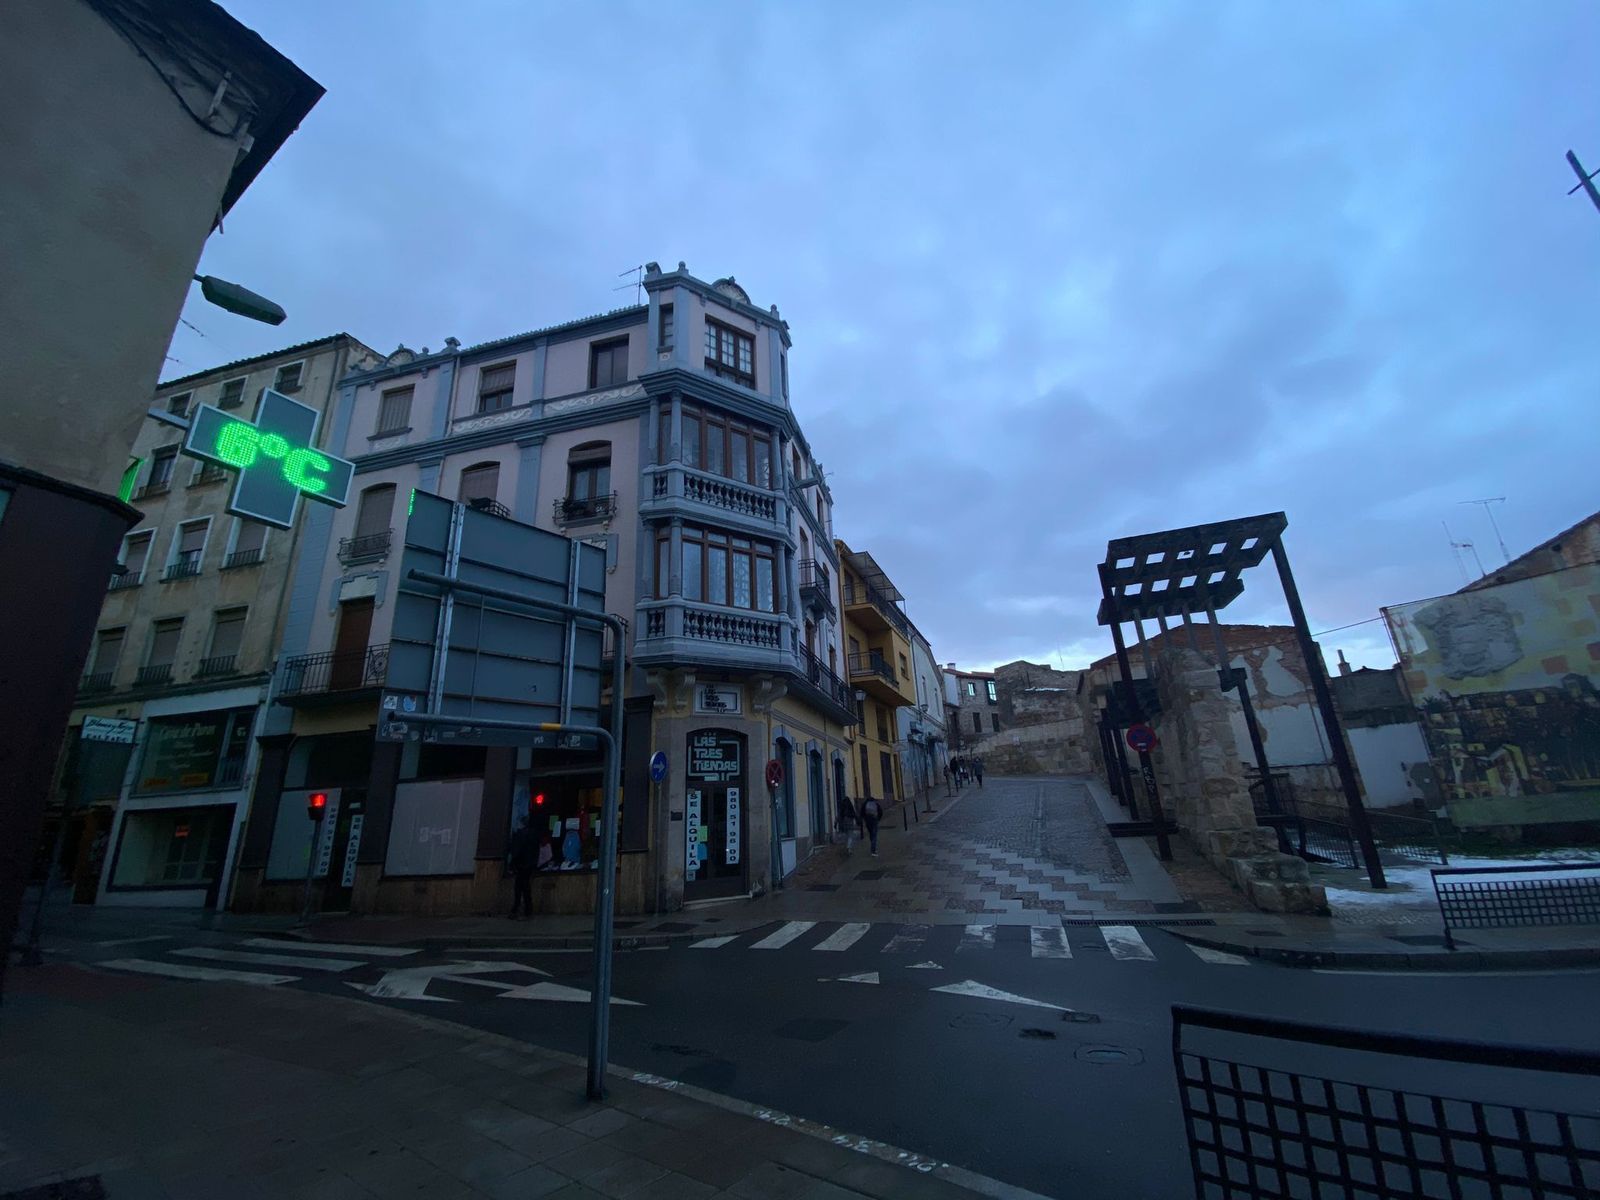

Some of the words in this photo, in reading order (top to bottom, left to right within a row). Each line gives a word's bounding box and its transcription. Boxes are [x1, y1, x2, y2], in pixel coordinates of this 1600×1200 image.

[694, 736, 716, 747] LAS
[693, 748, 723, 759] TRES
[693, 760, 737, 771] TIENDAS
[690, 794, 698, 807] SE
[353, 817, 361, 830] SE
[689, 813, 698, 866] ALQUILA
[343, 835, 359, 884] ALQUILA
